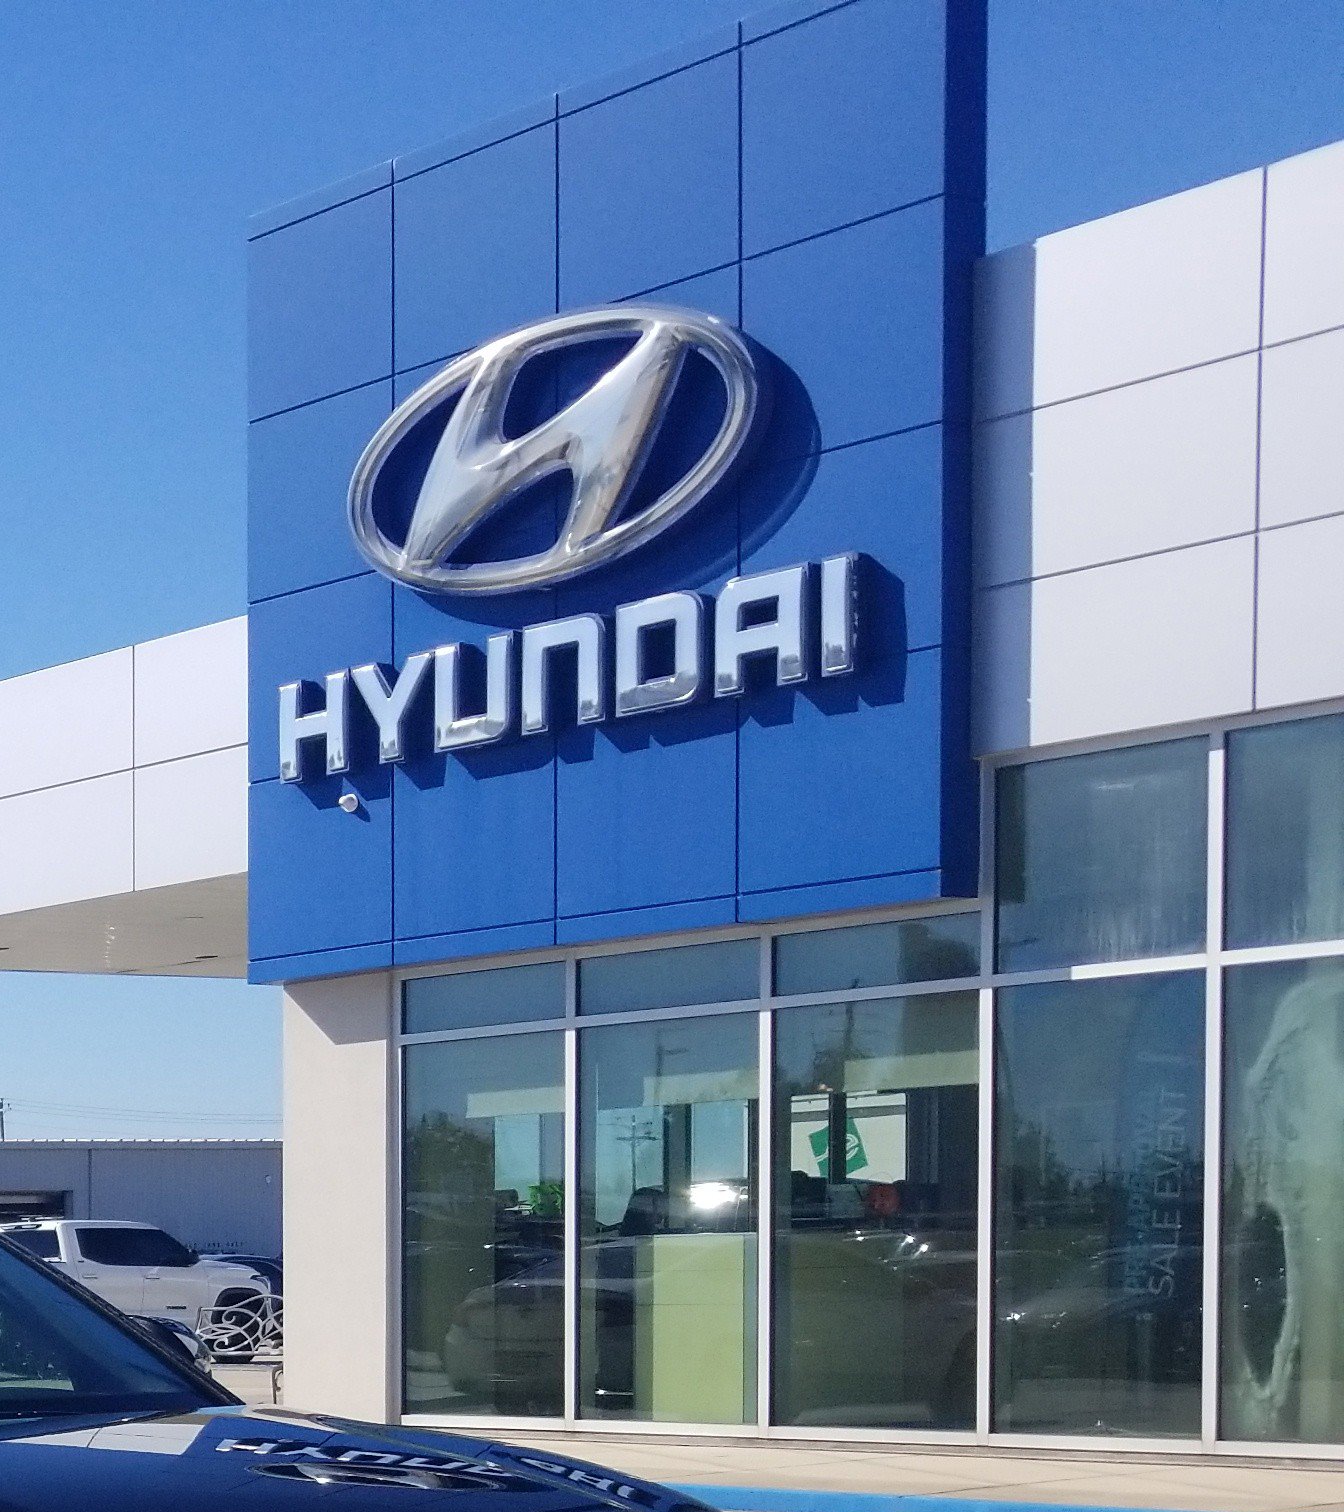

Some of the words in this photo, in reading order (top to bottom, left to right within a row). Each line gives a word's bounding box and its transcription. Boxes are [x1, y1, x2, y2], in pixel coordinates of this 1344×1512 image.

[279, 551, 859, 785] HYUNDAI
[1153, 1086, 1187, 1199] EVENT
[1148, 1209, 1182, 1298] SALE
